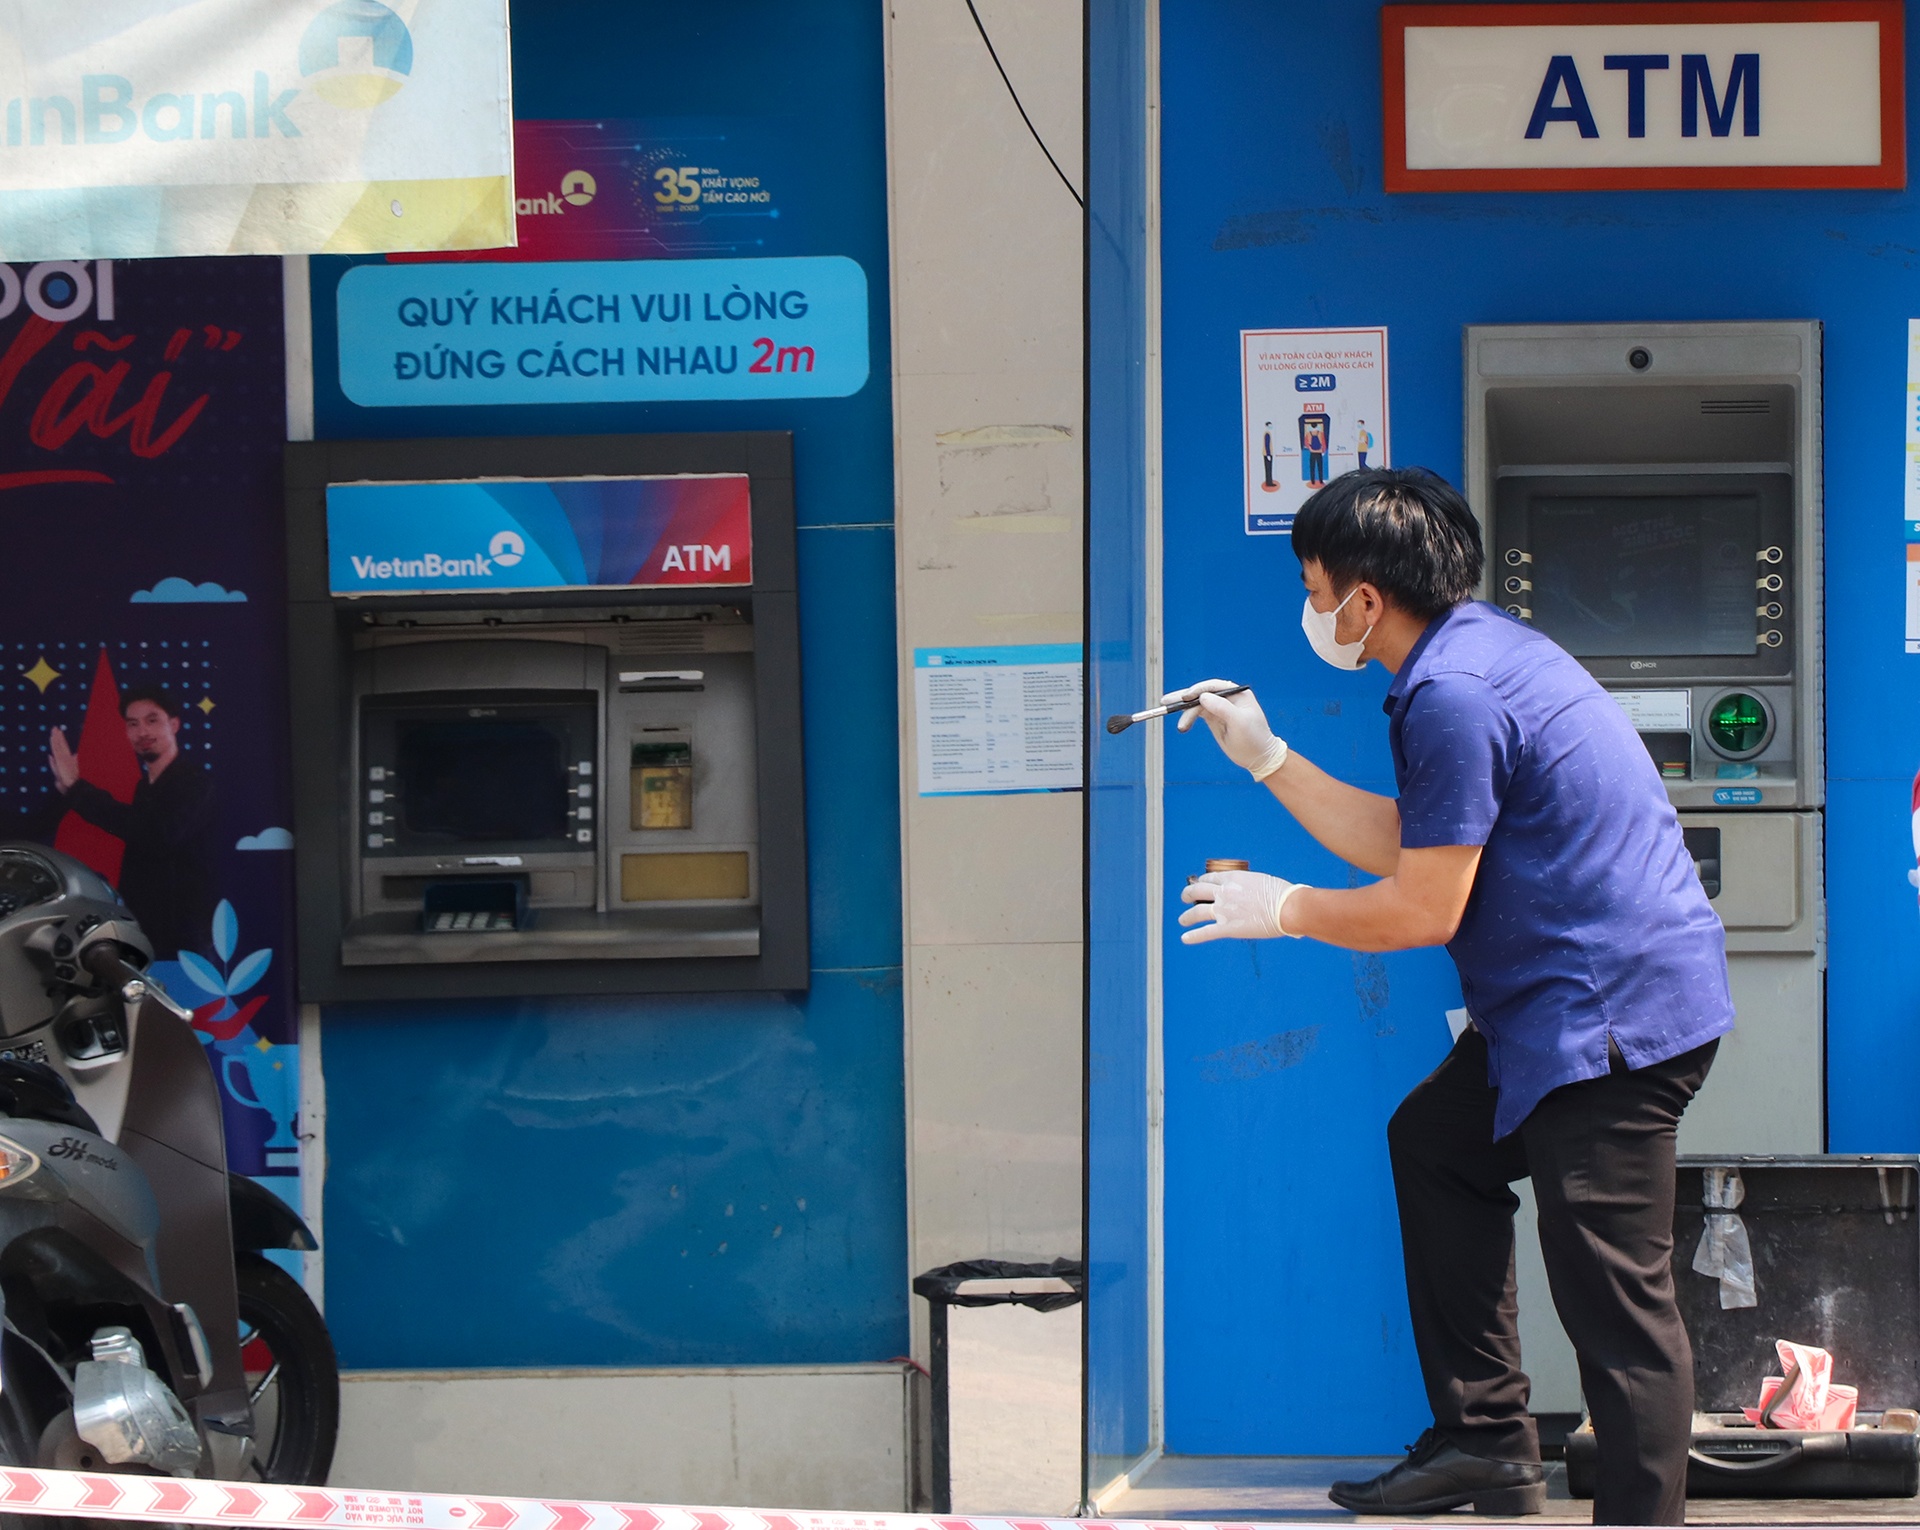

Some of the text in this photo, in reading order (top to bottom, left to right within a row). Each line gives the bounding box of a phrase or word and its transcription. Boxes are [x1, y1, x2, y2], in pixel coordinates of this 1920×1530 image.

[1524, 53, 1760, 139] ATM
[6, 70, 303, 147] inBank
[653, 167, 701, 204] 35
[702, 175, 760, 190] KHÁT VỌNG
[516, 191, 565, 215] ank
[725, 192, 748, 203] CAO
[398, 284, 809, 328] QUÝ KHÁCH VUI LÒNG
[393, 337, 816, 380] ĐỨNG CÁCH NHAU 2m
[1259, 352, 1267, 360] VÌ
[1283, 351, 1305, 360] TOÀN
[1306, 351, 1323, 360] CỦA
[1344, 350, 1373, 359] KHÁCH
[1258, 363, 1272, 371] VUI
[1352, 360, 1374, 369] CÁCH
[1310, 376, 1330, 388] 2M
[1305, 403, 1324, 412] ATM
[350, 544, 731, 579] VietinBank ATM
[47, 1137, 88, 1160] SH
[345, 1512, 424, 1524] KHU VỰC CẤM VÀO
[368, 1505, 404, 1513] ALLOWED
